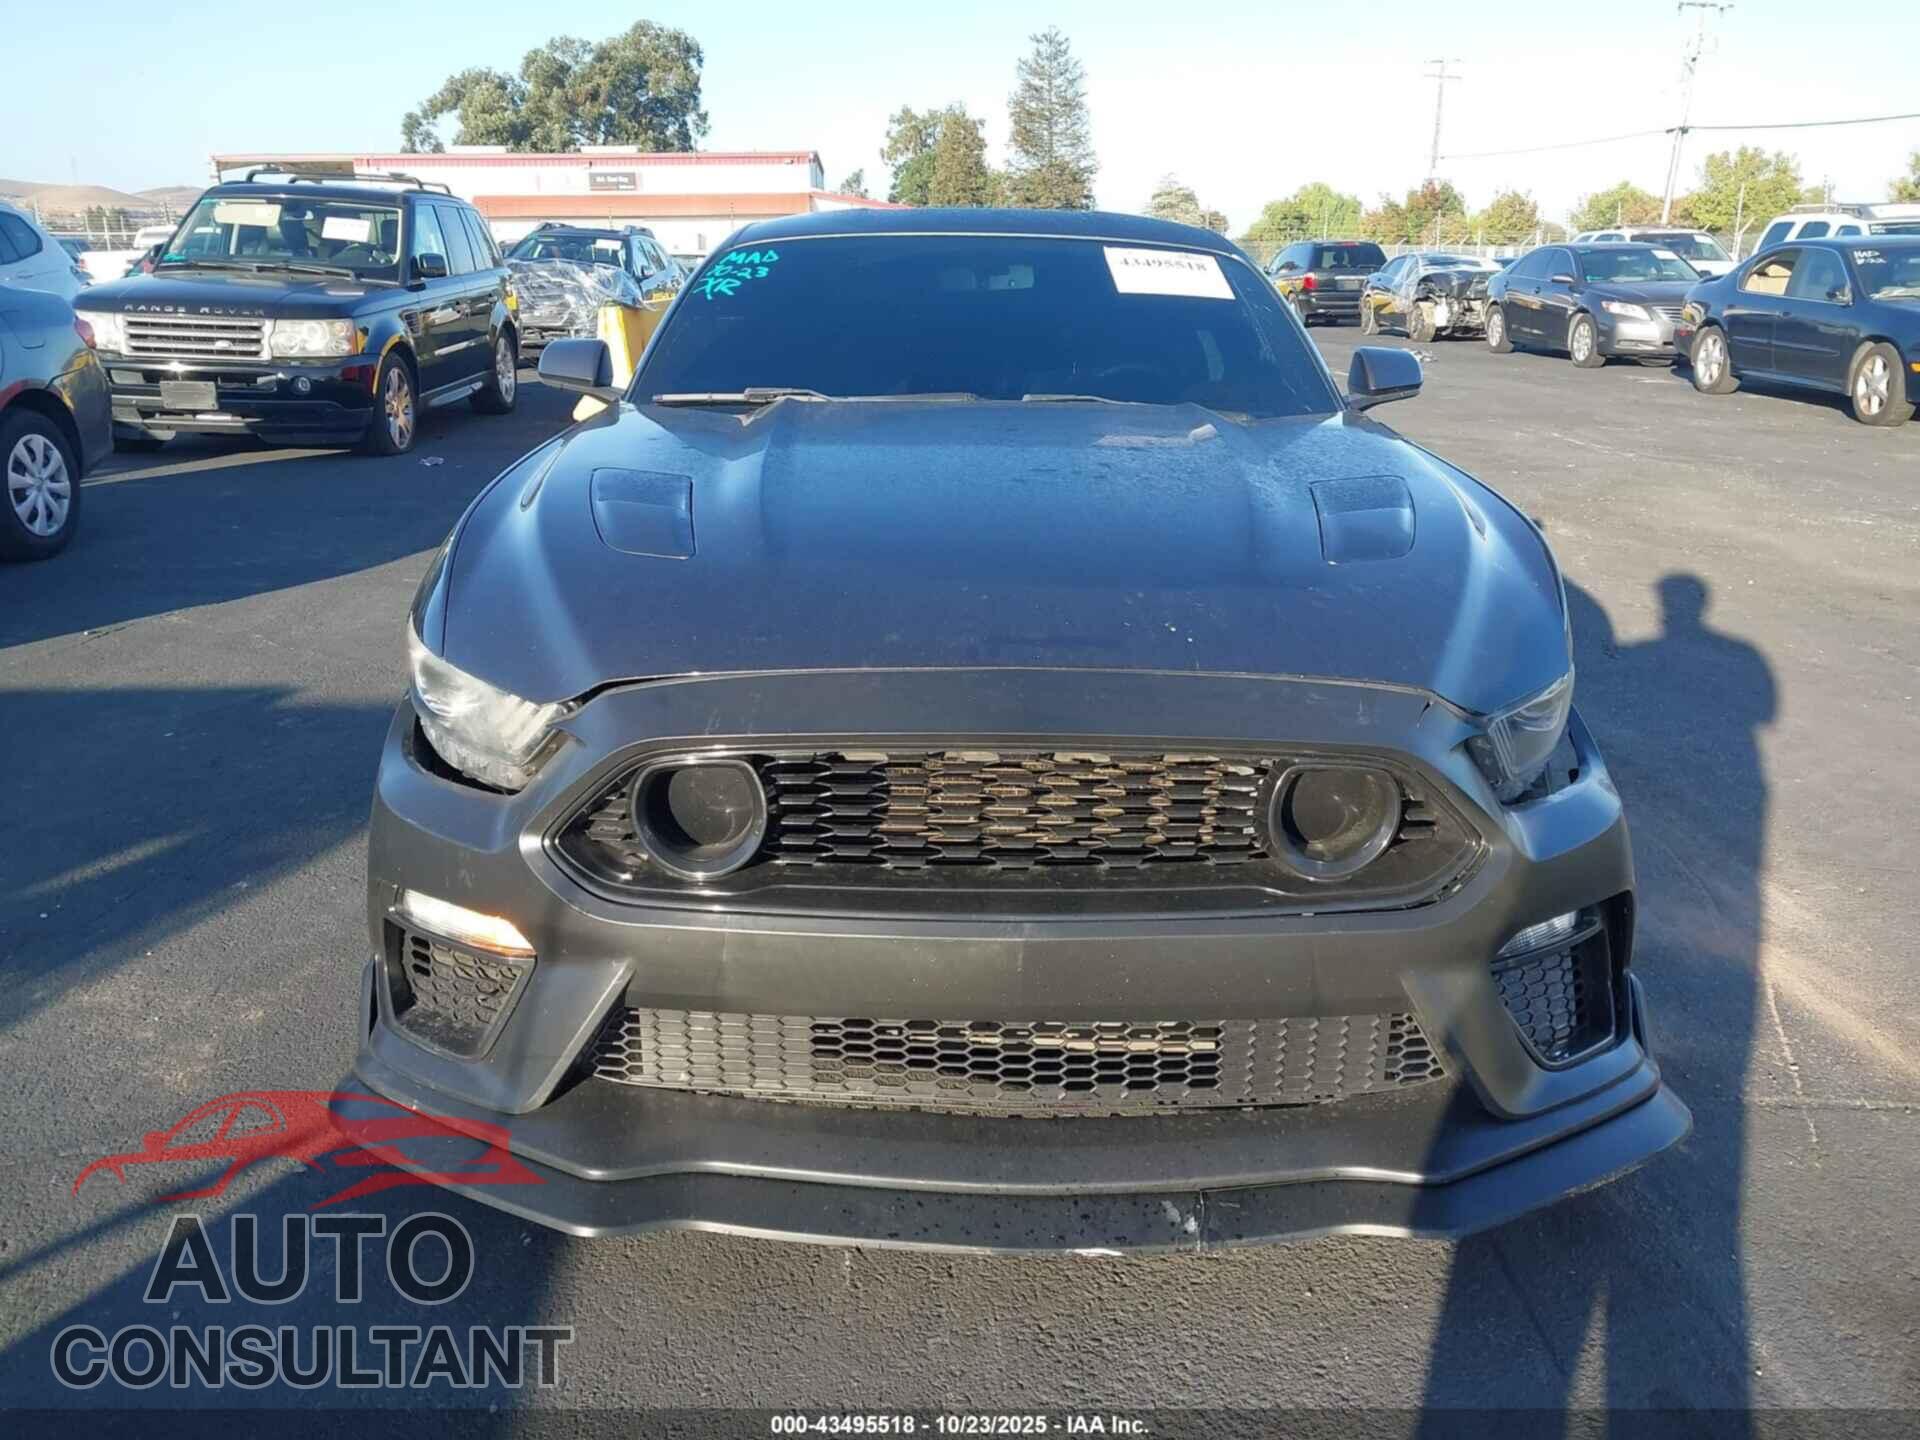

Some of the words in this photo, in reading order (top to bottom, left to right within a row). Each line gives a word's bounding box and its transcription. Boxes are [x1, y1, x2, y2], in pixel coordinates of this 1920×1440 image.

[720, 249, 779, 264] MAD
[124, 304, 187, 313] RANGE
[199, 307, 265, 316] ROVER
